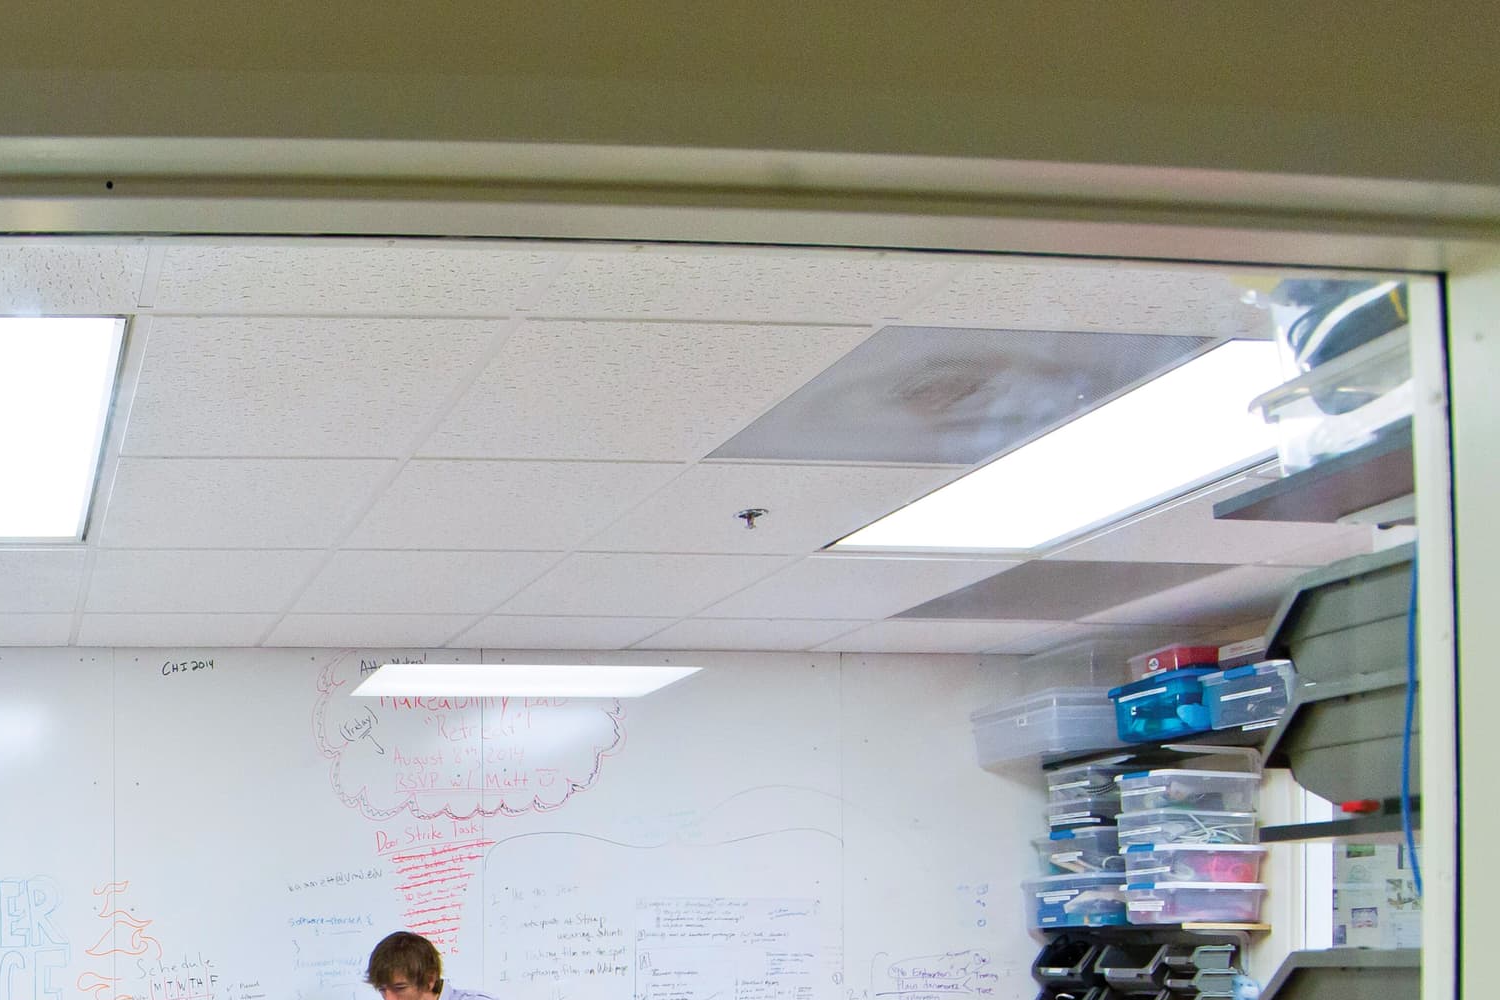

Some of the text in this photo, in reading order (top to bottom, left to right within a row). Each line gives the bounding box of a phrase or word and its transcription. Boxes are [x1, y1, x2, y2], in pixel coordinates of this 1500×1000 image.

[162, 659, 214, 676] CHI 2014
[393, 746, 445, 772] August
[485, 771, 529, 788] Matt
[403, 824, 444, 845] Strike
[137, 951, 216, 979] Schedule
